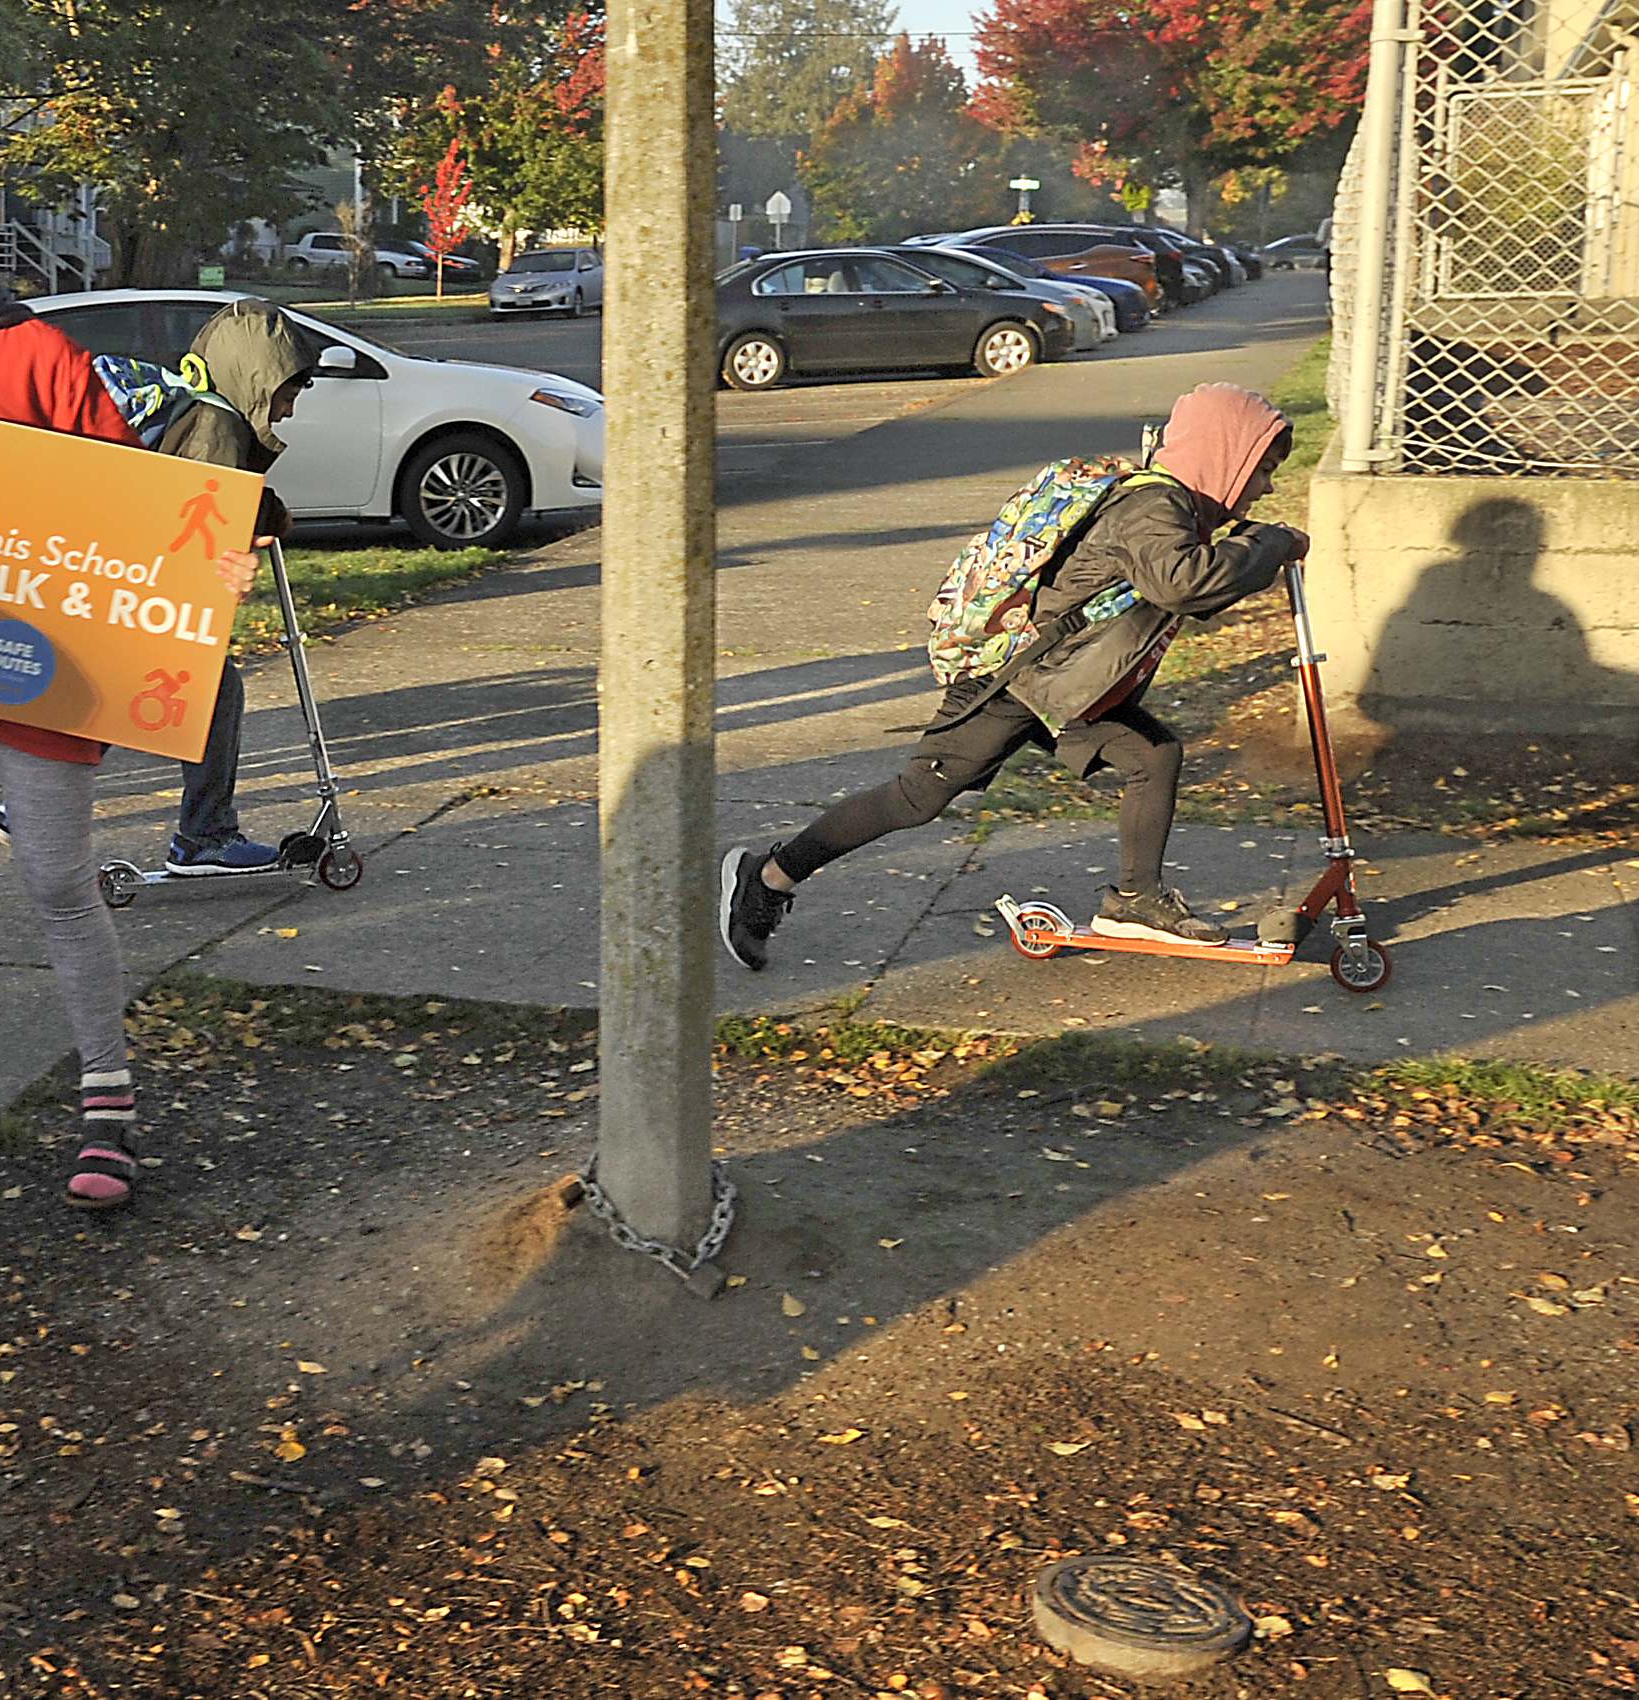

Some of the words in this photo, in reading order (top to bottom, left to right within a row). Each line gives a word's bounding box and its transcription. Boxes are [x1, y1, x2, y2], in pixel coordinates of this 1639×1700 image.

[39, 535, 165, 587] School
[61, 581, 93, 619] &
[107, 588, 219, 646] ROLL
